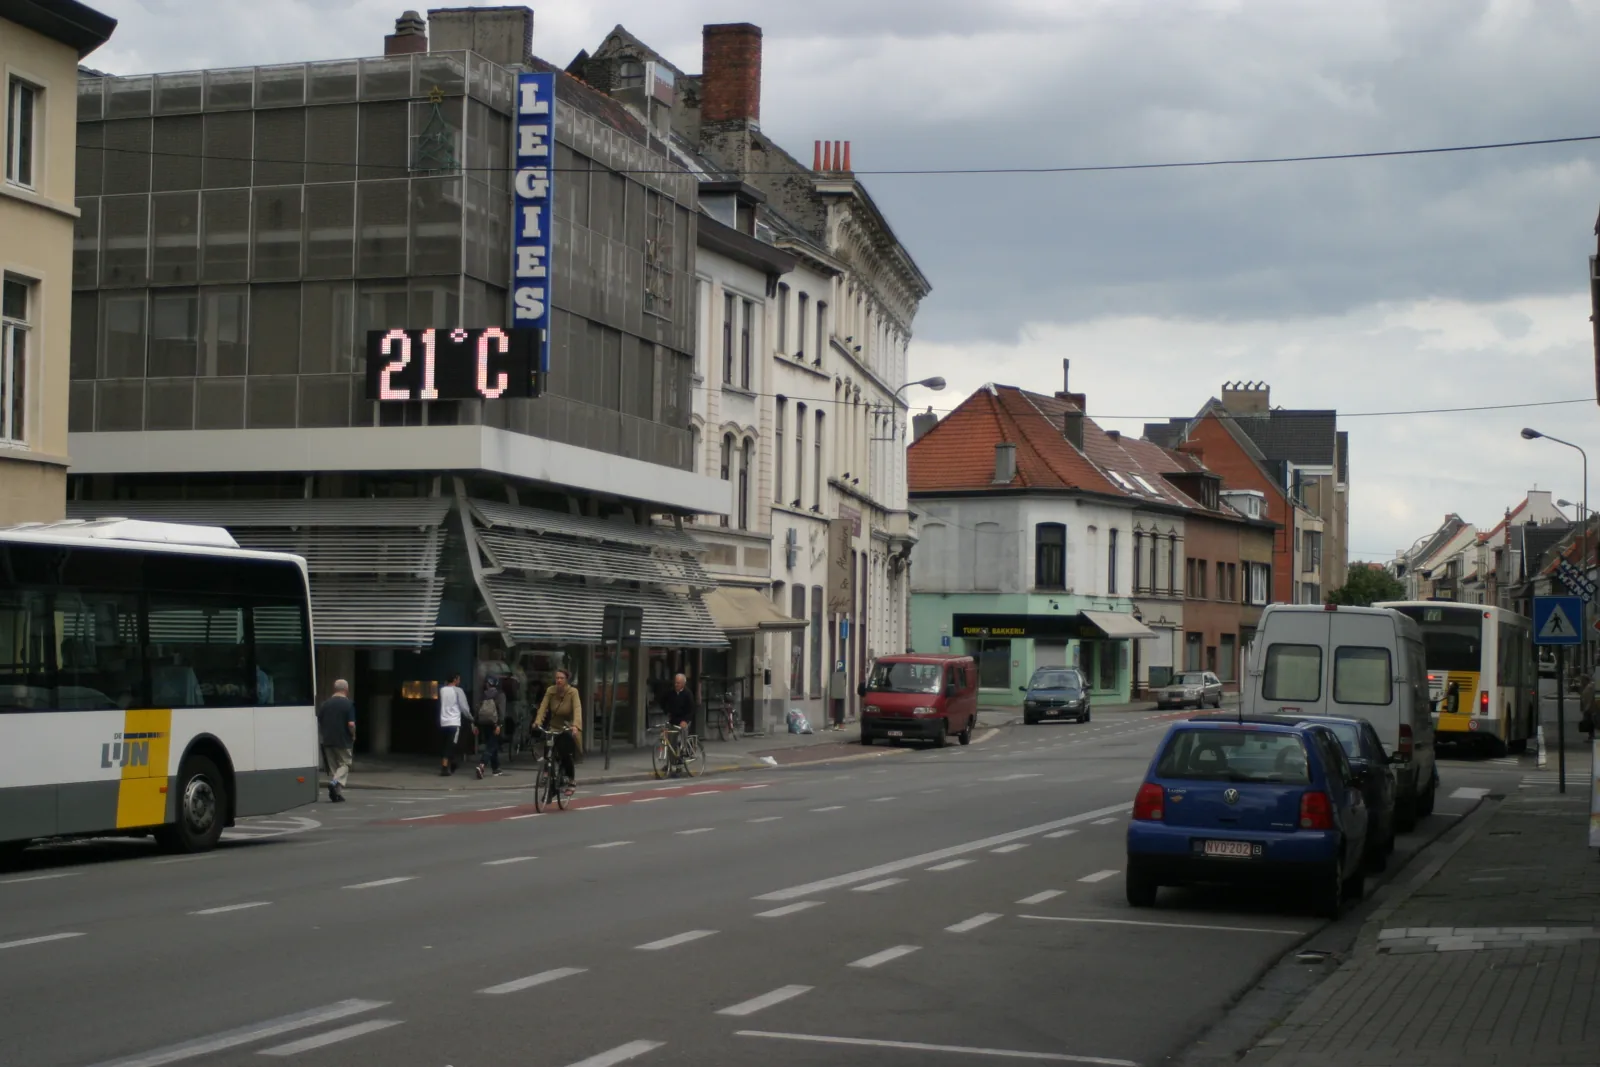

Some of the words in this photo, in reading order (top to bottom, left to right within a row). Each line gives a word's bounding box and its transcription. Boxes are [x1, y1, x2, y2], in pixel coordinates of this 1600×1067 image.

[515, 83, 549, 342] LEGIES
[963, 627, 989, 636] TURK
[991, 627, 1026, 635] BAKKERIJ
[101, 742, 150, 768] LIJN
